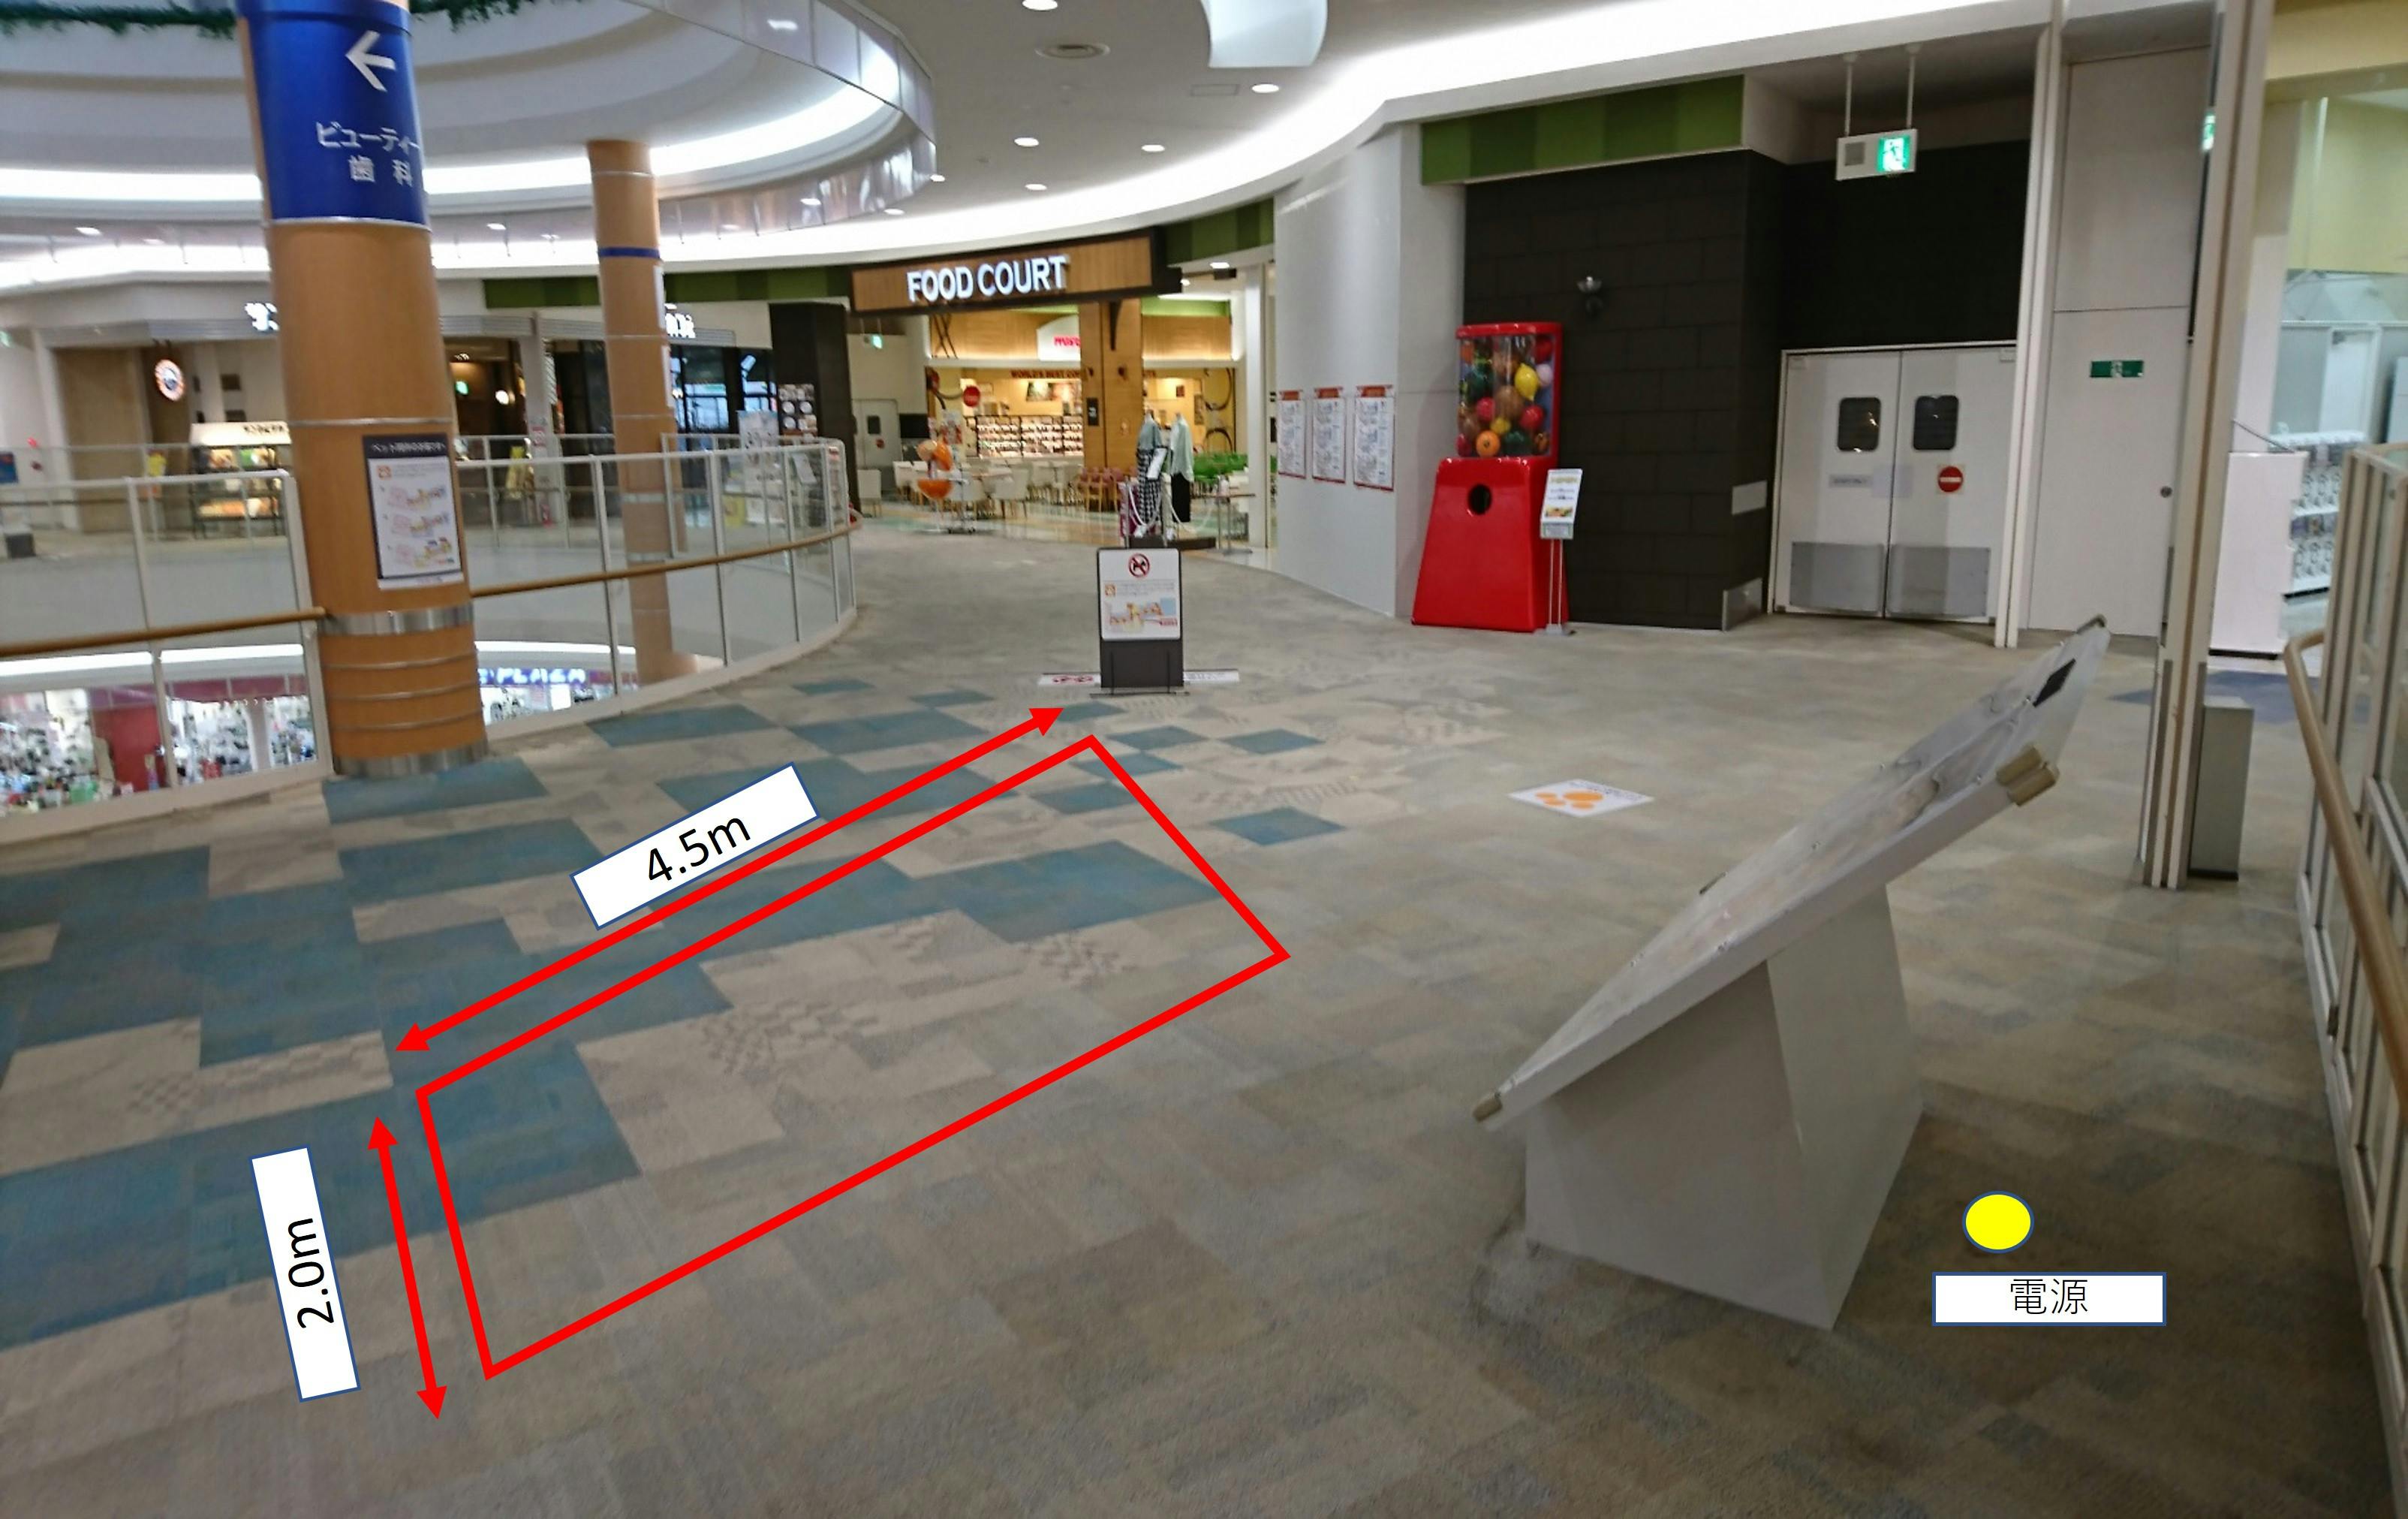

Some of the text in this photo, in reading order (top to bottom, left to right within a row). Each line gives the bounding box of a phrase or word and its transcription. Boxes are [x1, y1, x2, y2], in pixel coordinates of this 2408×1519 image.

[315, 121, 420, 155] ビューティー
[907, 255, 1067, 303] FOOD COURT
[496, 667, 586, 684] PLAZA
